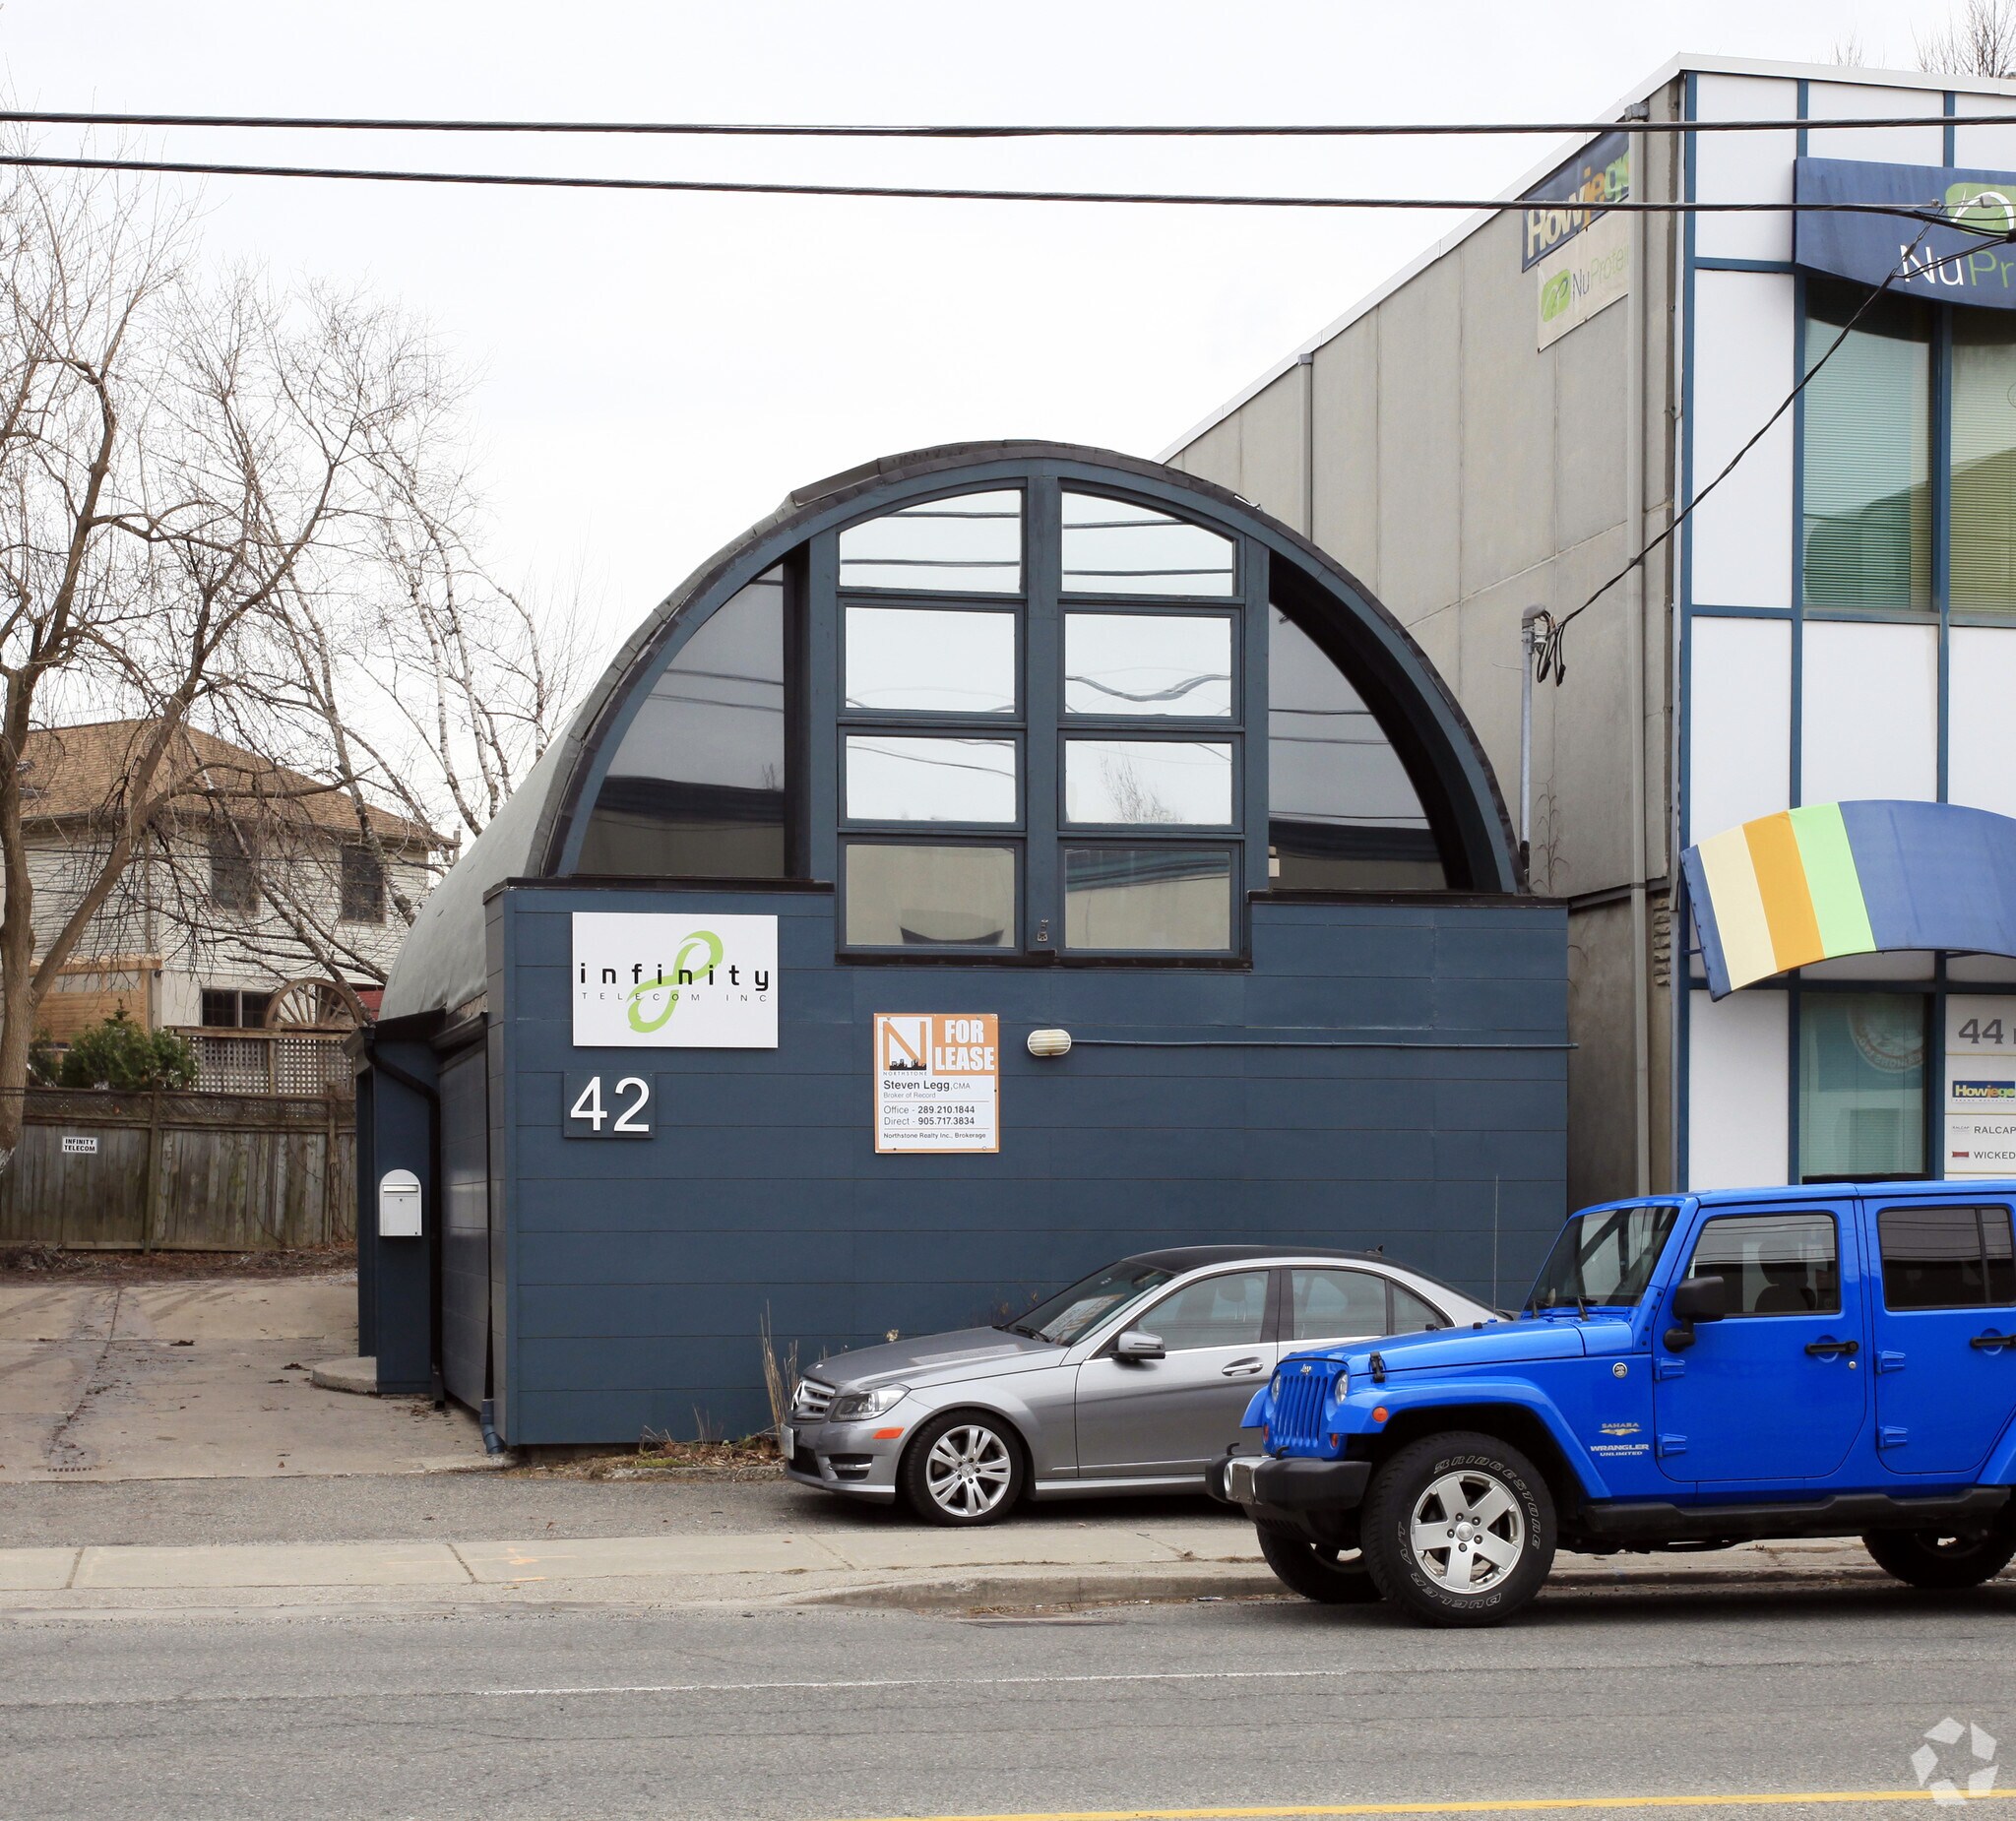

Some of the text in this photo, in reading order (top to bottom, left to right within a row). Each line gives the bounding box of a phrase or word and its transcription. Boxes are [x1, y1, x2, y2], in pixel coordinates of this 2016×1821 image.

[1900, 245, 2015, 288] NuPr
[580, 963, 769, 992] infinity
[582, 992, 767, 1003] TELECOM INC
[943, 1019, 984, 1044] FOR
[1958, 1018, 2005, 1045] 44
[934, 1046, 995, 1072] LEASE
[883, 1079, 920, 1090] Steven
[570, 1076, 650, 1132] 42
[883, 1104, 910, 1114] Office
[917, 1105, 976, 1114] 289.210.1844
[884, 1116, 910, 1126] Direct
[917, 1116, 976, 1126] 905.717.3834
[1974, 1125, 2016, 1134] RALCAP
[1974, 1151, 2016, 1160] WICKED
[1590, 1443, 1650, 1452] WRANGLER
[1433, 1455, 1542, 1550] BRIDGESTONE
[1410, 1572, 1502, 1609] DUELER
